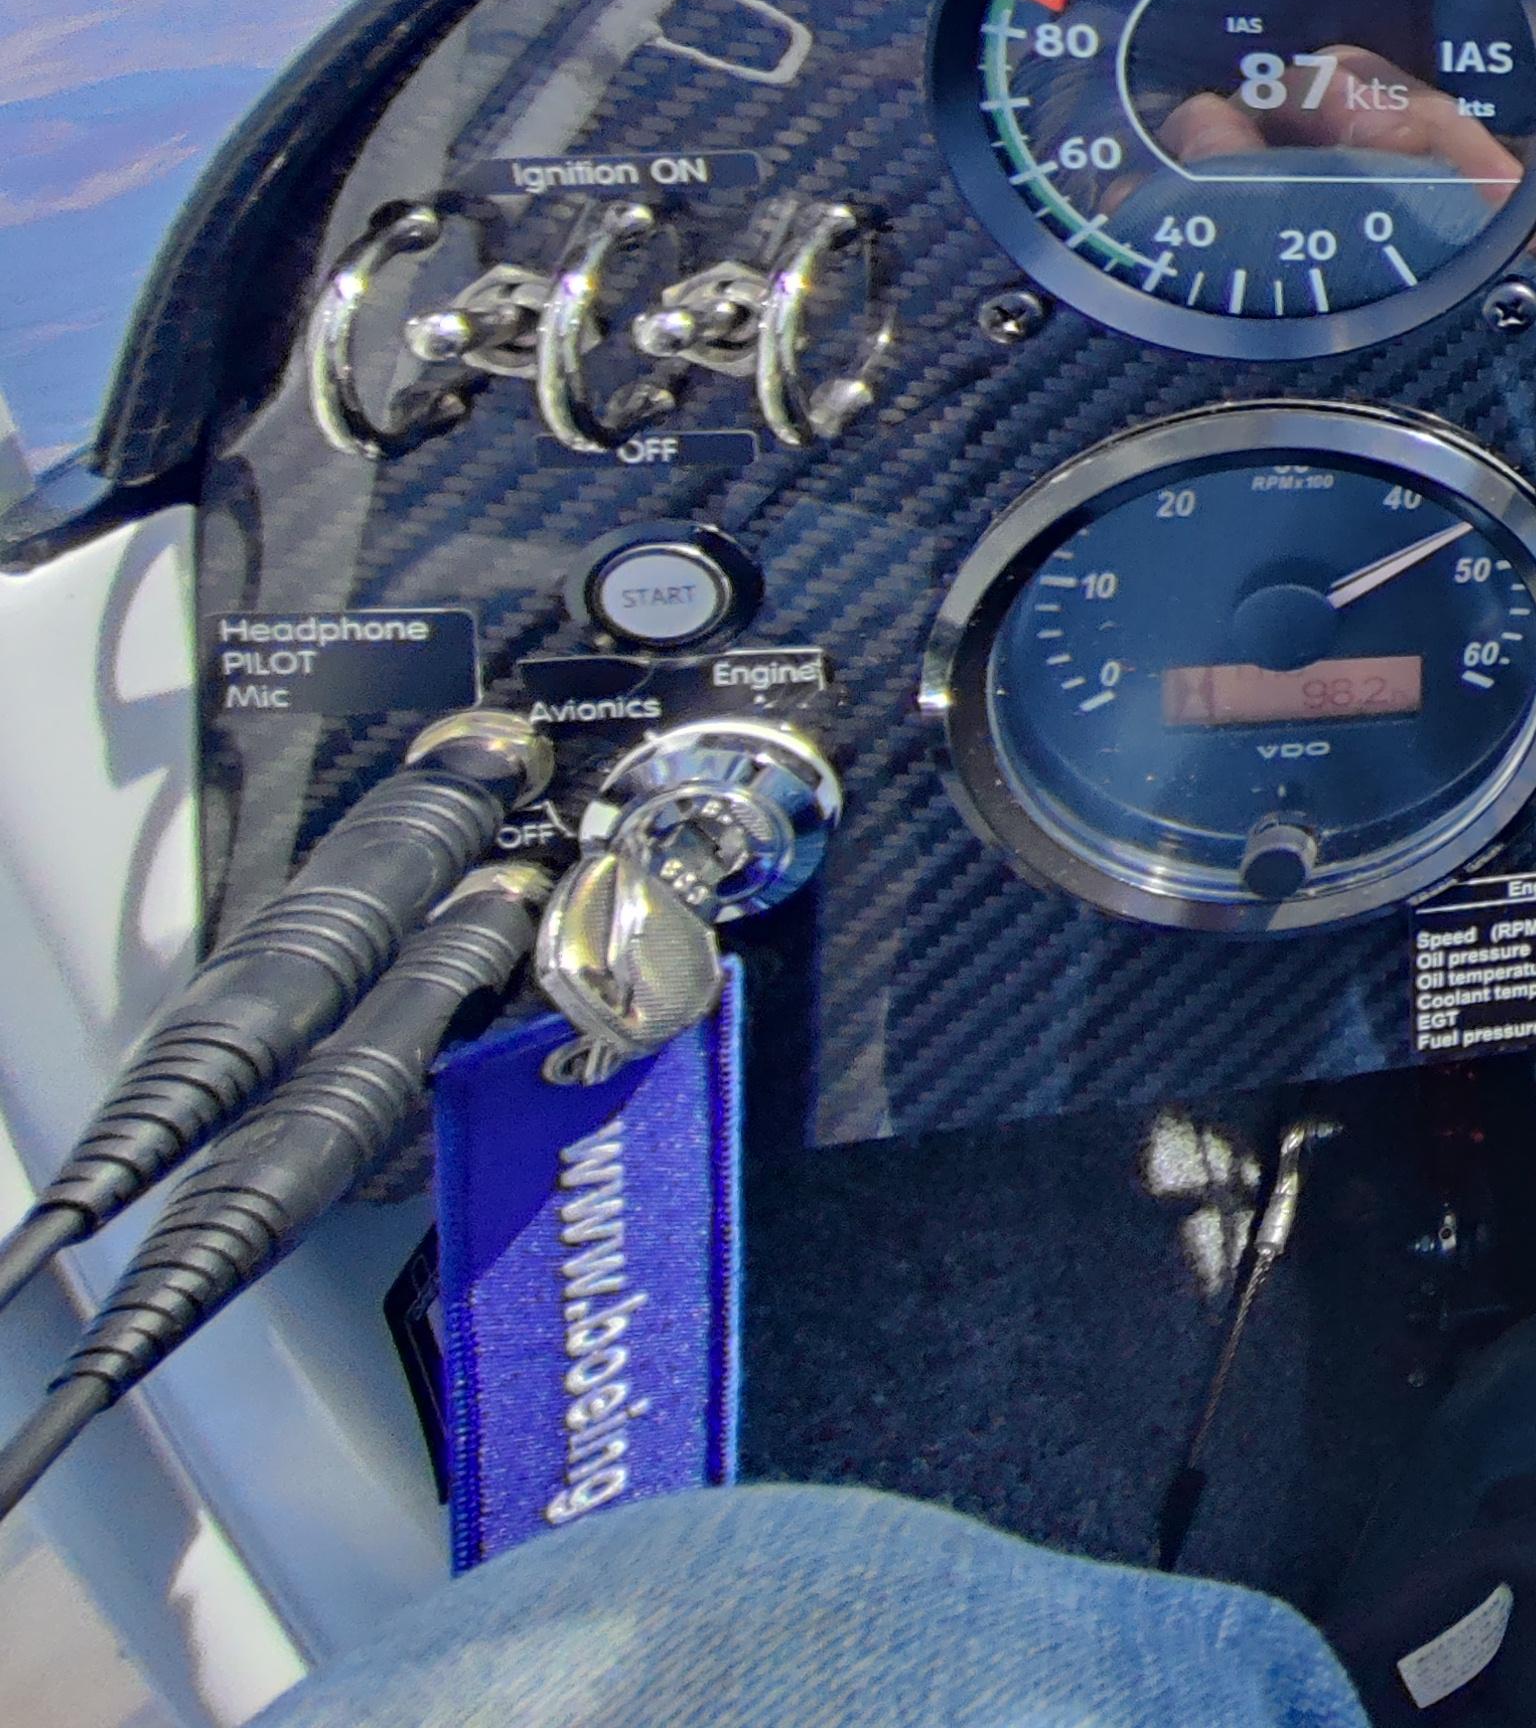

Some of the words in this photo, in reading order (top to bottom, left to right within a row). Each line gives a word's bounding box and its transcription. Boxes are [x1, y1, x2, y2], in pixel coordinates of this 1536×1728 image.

[1227, 17, 1263, 34] IAS
[1034, 24, 1098, 58] 80
[1439, 41, 1513, 73] IAS
[1239, 53, 1338, 111] 87
[1346, 76, 1409, 111] kts
[1458, 97, 1495, 118] kts
[513, 160, 638, 192] Ignition
[651, 158, 707, 183] ON
[1154, 216, 1216, 247] 40
[618, 439, 678, 463] OFF
[1156, 491, 1196, 517] 20
[1454, 558, 1490, 582] 50
[621, 584, 697, 609] START
[219, 619, 428, 644] Headphone
[222, 651, 316, 675] PILOT
[1463, 642, 1498, 666] 60
[714, 662, 815, 688] Engine
[225, 685, 290, 708] Mic
[530, 697, 661, 722] Avionics
[1257, 742, 1330, 759] VDO
[1416, 926, 1478, 950] Speed
[1416, 950, 1443, 969] Oil
[1449, 944, 1531, 968] pressure
[1416, 971, 1444, 990] Oil
[1417, 989, 1490, 1010] Coolant
[1417, 1010, 1460, 1030] EGT
[1418, 1030, 1459, 1051] Fuel
